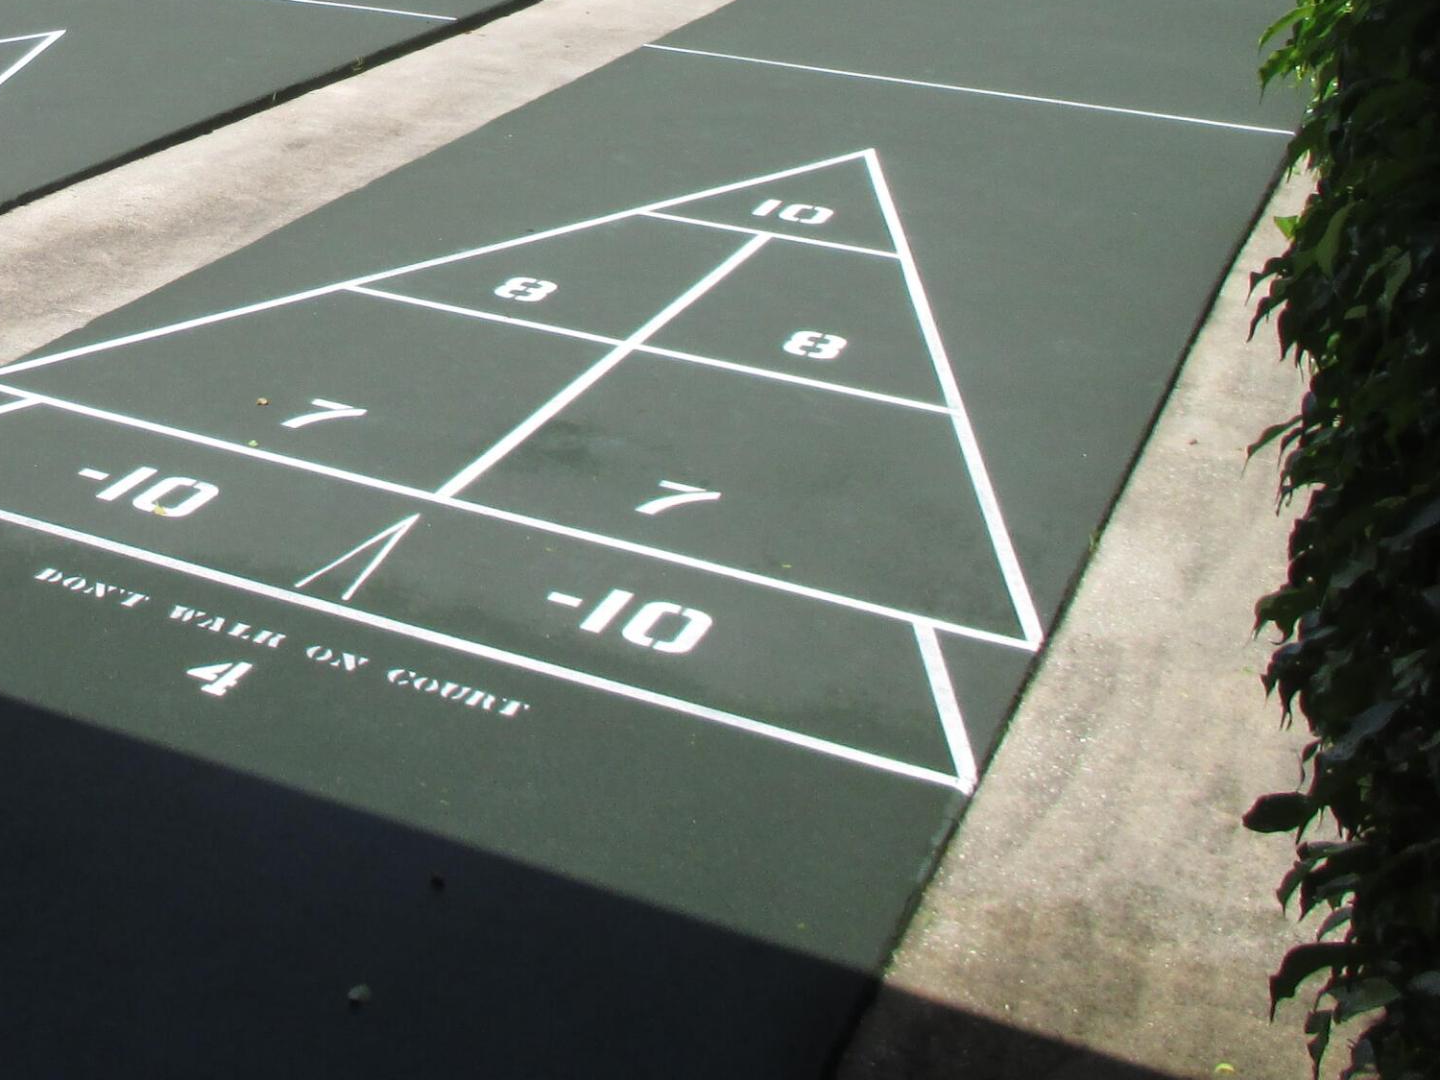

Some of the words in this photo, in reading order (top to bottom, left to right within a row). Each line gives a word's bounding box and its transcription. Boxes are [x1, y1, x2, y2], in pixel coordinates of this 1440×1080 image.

[753, 199, 833, 225] 10
[494, 277, 557, 301] 8
[783, 331, 847, 359] 8
[282, 399, 367, 428] 7
[79, 467, 219, 517] -10
[635, 480, 721, 515] 7
[548, 589, 712, 653] -10
[169, 604, 287, 648] WALK
[307, 646, 368, 670] ON
[387, 668, 531, 717] COURT
[187, 662, 252, 696] 4
